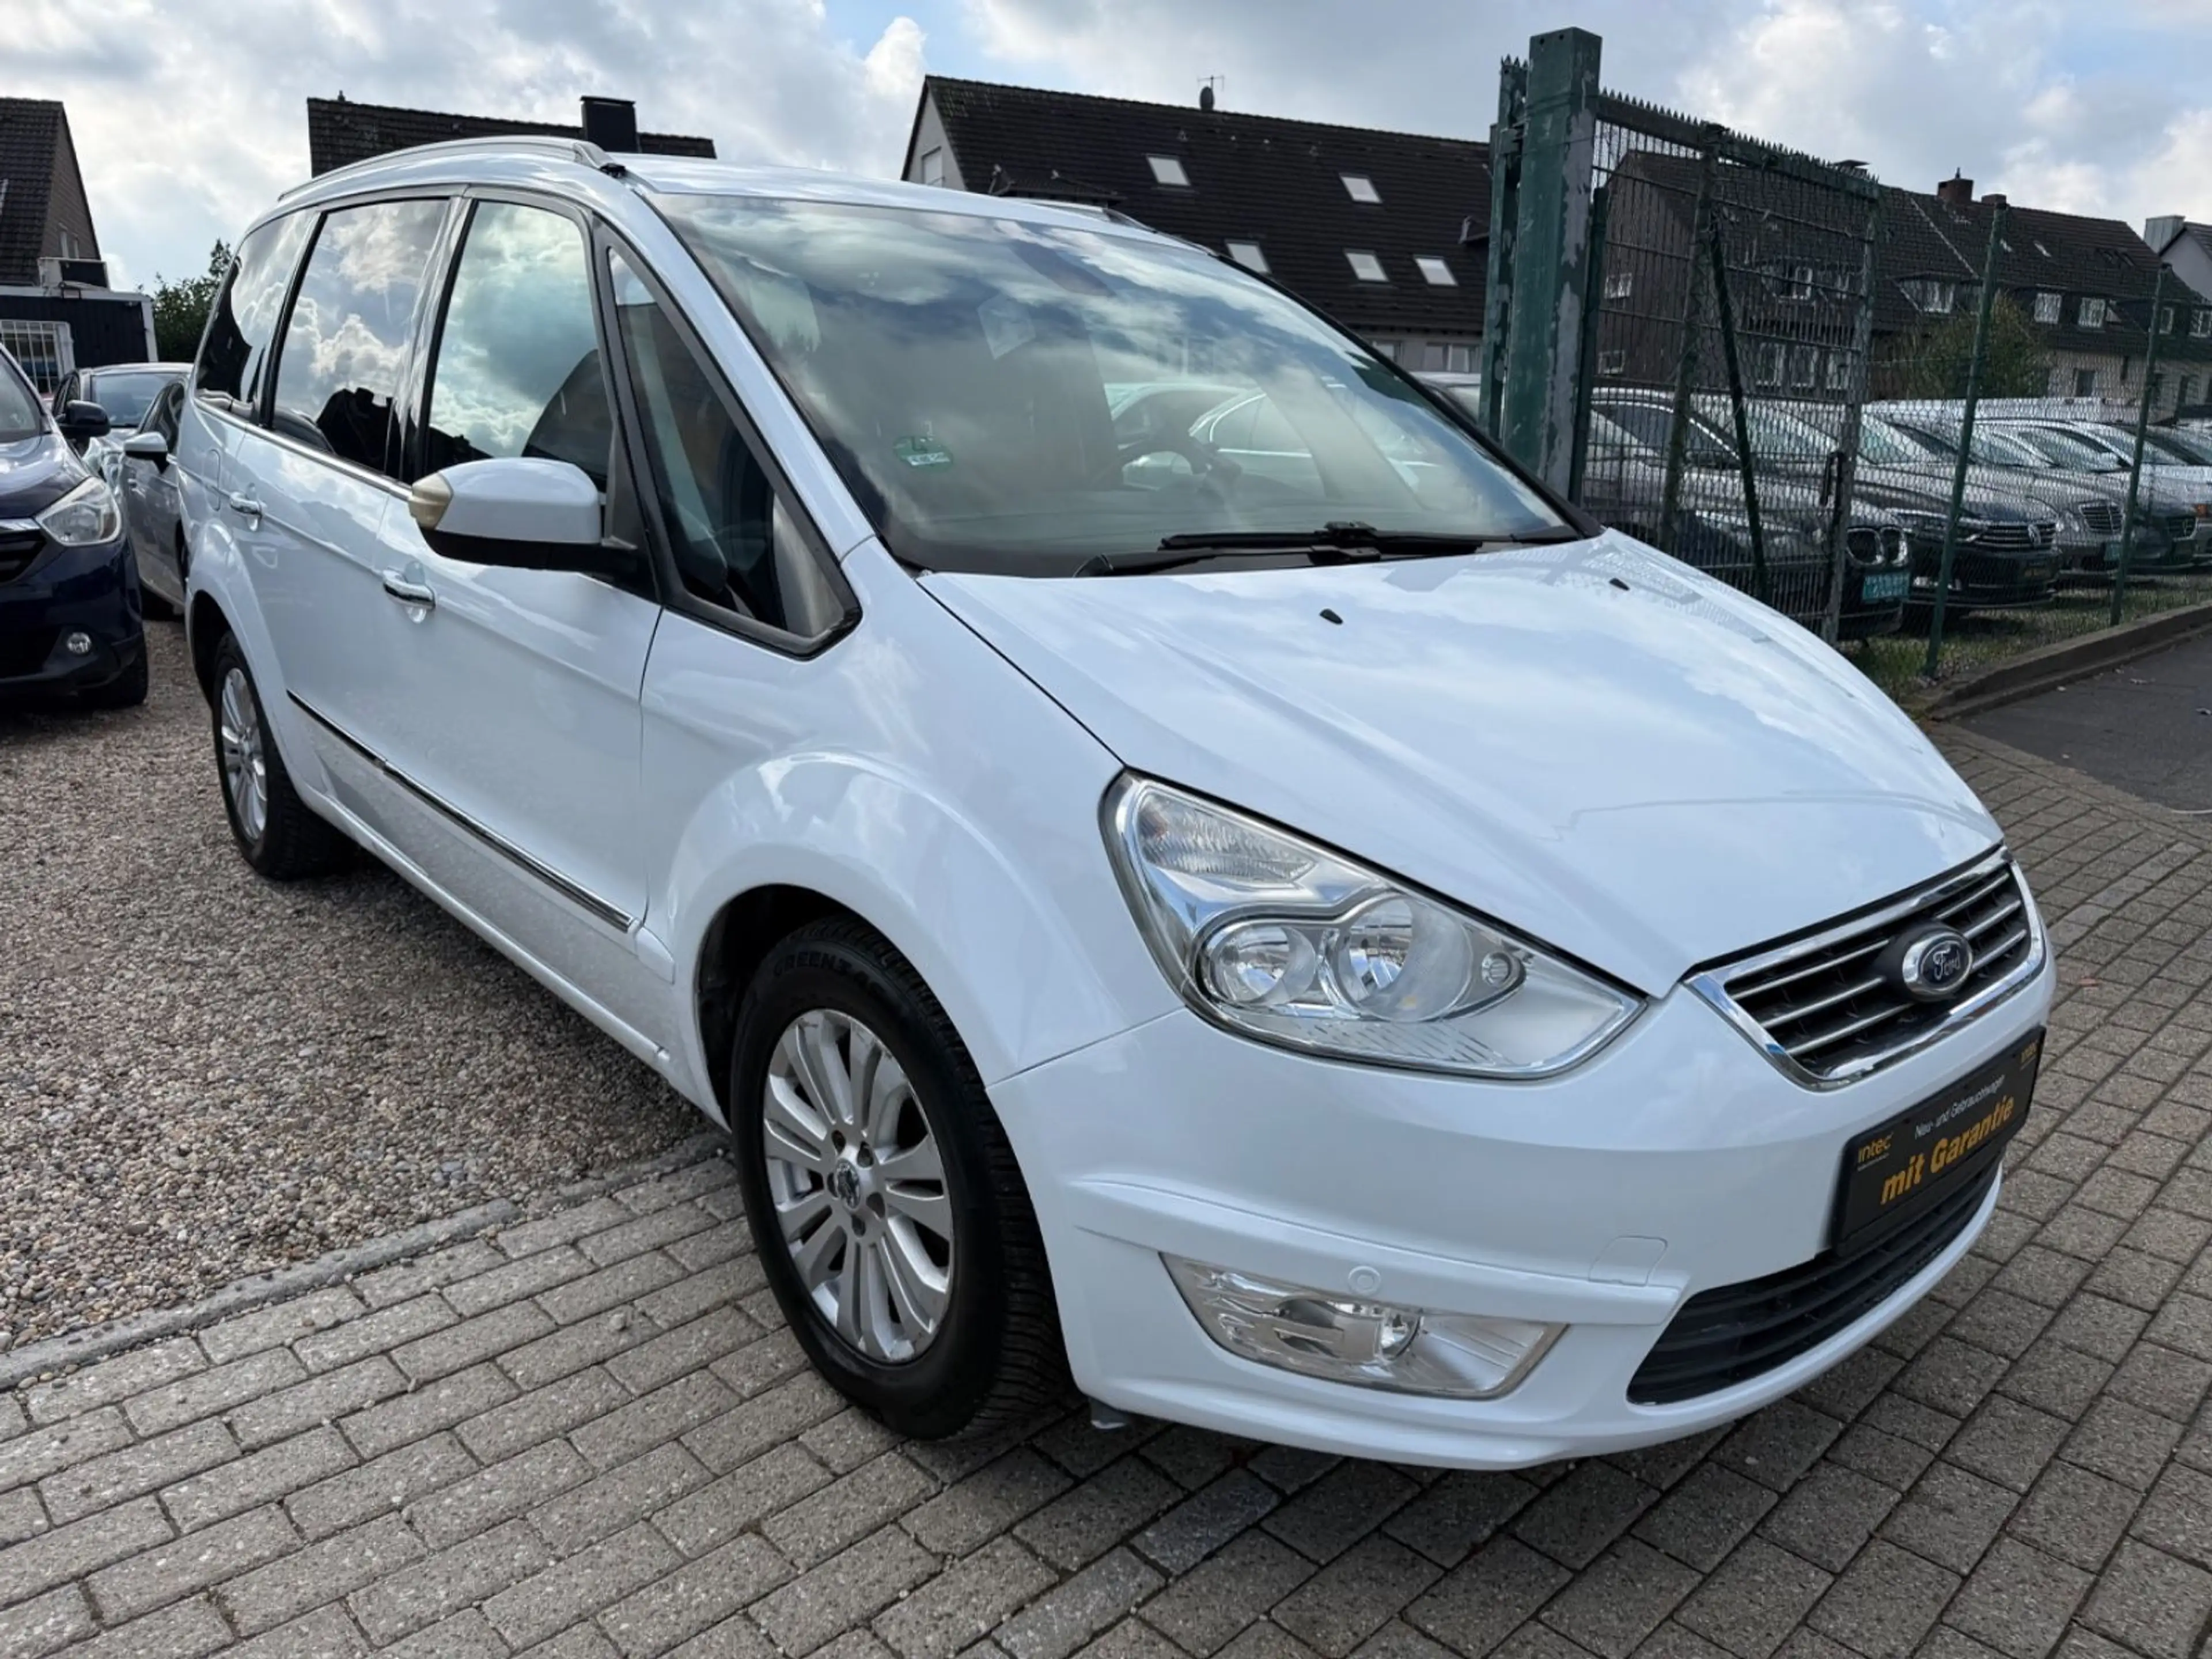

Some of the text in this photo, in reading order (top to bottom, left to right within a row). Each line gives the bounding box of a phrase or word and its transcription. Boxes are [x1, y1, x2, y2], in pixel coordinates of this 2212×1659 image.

[1933, 944, 1961, 980] Ford
[1880, 1095, 2014, 1205] mit Garantie
